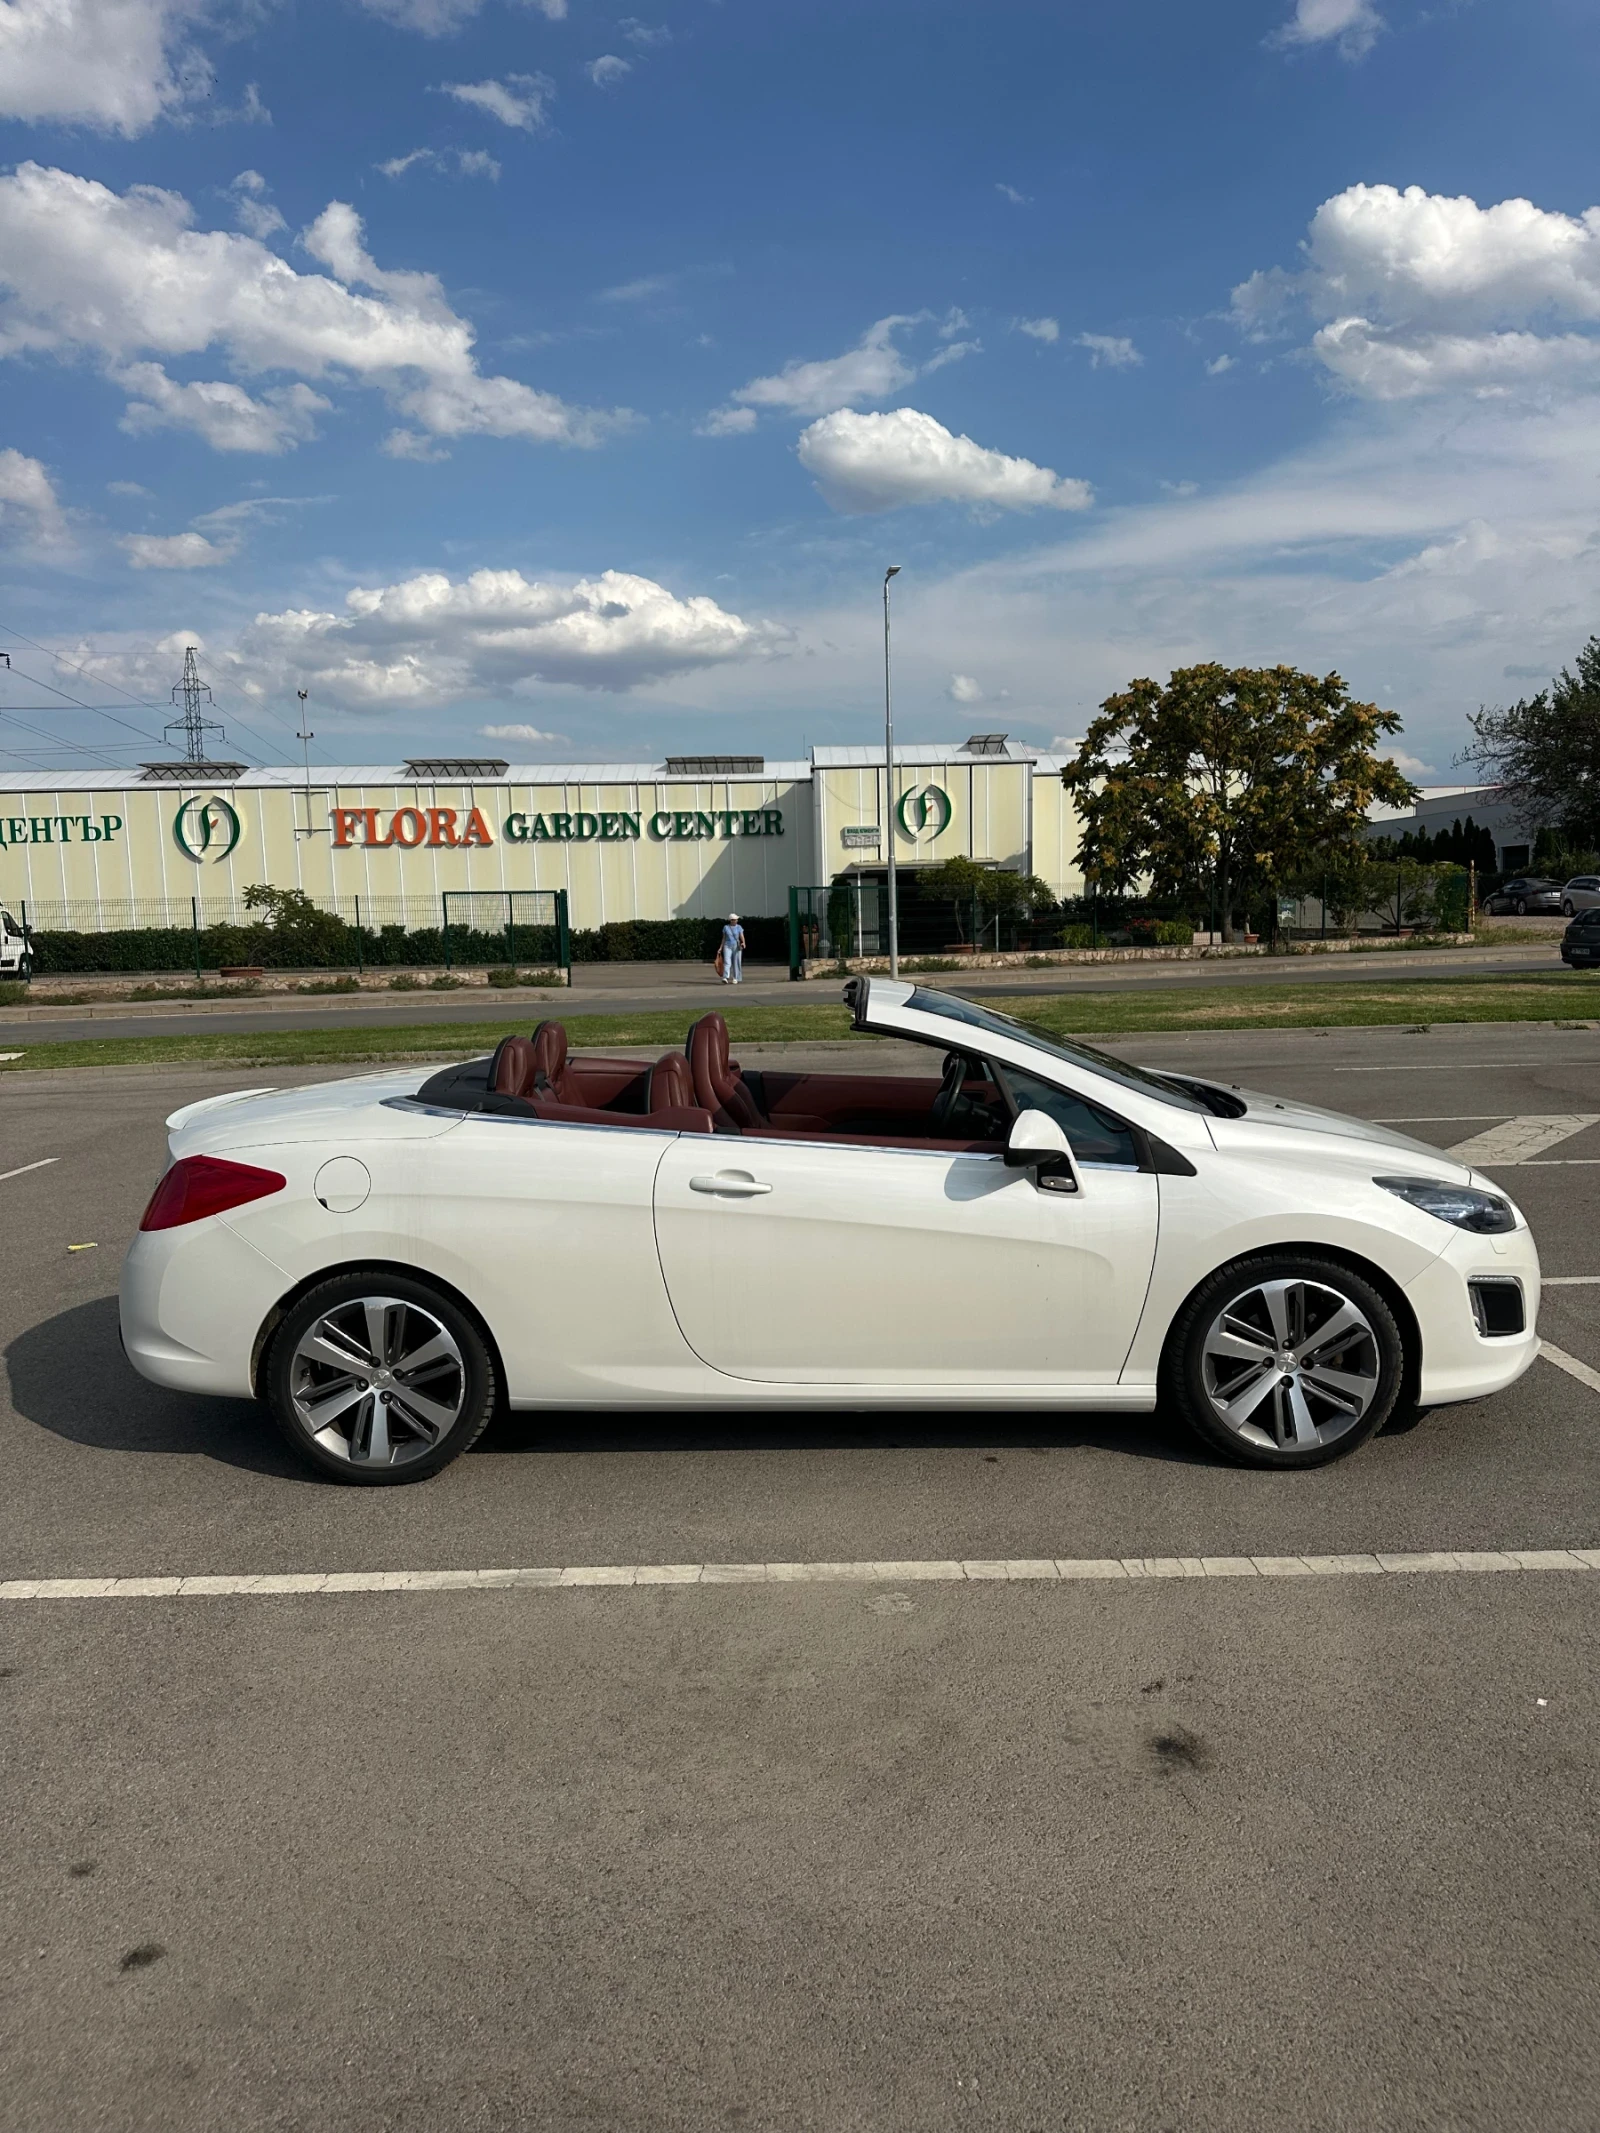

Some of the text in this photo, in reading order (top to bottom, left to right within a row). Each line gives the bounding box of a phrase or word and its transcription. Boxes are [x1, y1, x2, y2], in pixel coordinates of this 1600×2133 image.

[332, 807, 785, 846] FLORA GARDEN CENTER
